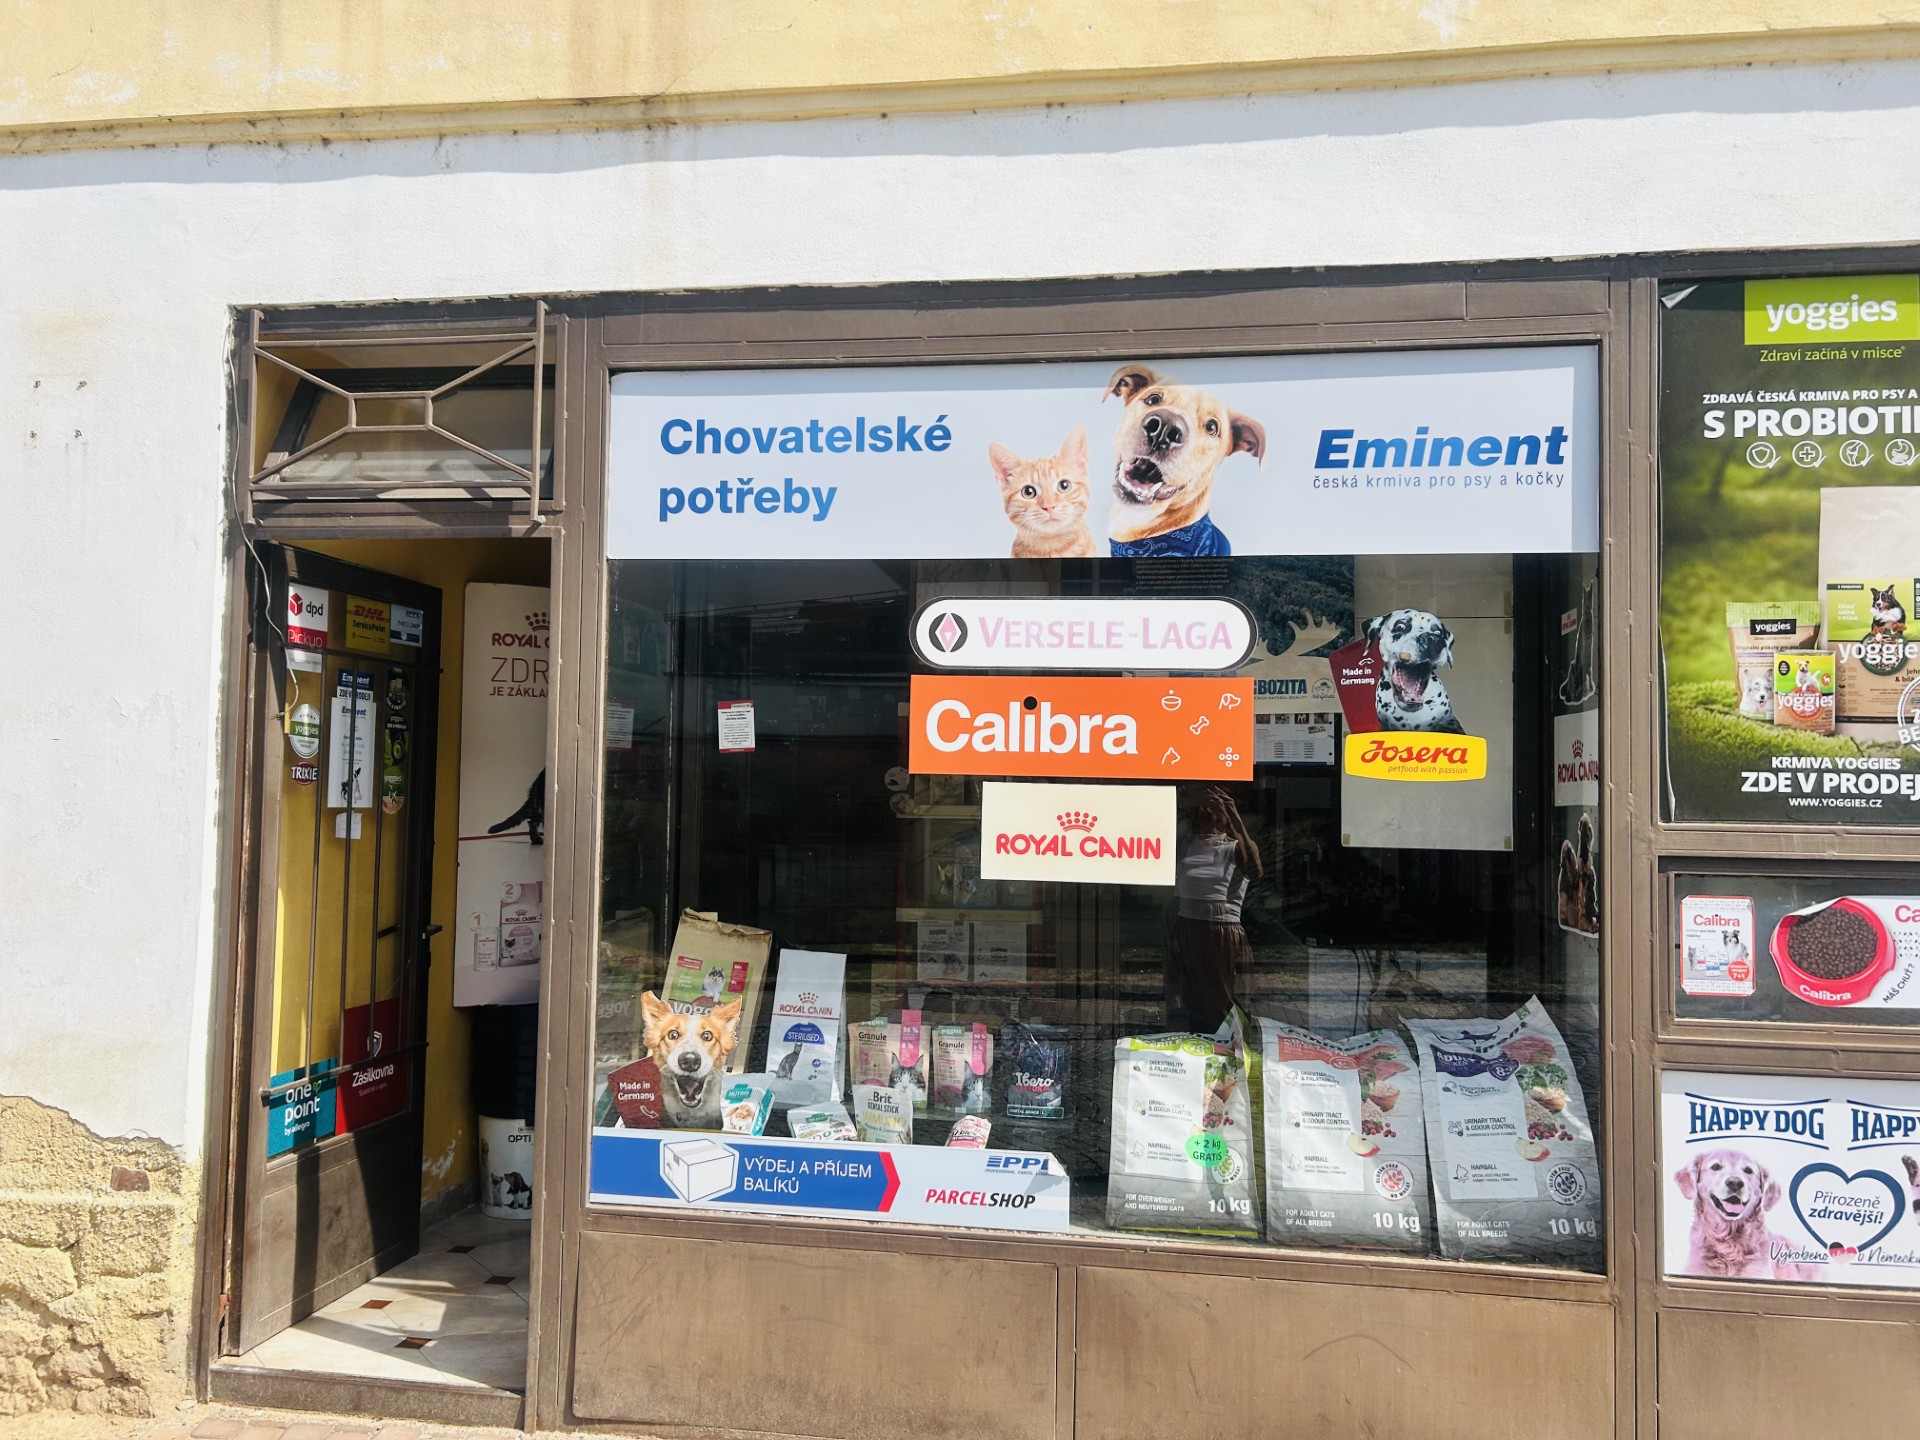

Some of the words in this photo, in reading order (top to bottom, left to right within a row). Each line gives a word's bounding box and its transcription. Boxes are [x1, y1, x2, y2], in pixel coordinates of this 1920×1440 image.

[1766, 294, 1897, 332] yoggies
[1760, 349, 1801, 362] Zdraví
[1804, 348, 1847, 361] začíná
[1850, 350, 1859, 359] v
[1702, 390, 1754, 404] ZDRAVÁ
[1757, 389, 1796, 402] ČESKÁ
[1799, 390, 1850, 401] KRMIVA
[1852, 390, 1878, 400] PRO
[1882, 389, 1905, 399] PSY
[1908, 388, 1918, 399] A
[1703, 409, 1726, 439] S
[1734, 405, 1920, 438] PROBIOTI
[660, 414, 952, 455] Chovatelské
[1314, 425, 1569, 470] Eminent
[1313, 473, 1358, 490] česká
[1366, 472, 1421, 488] krmiva
[1429, 475, 1456, 490] pro
[1464, 474, 1492, 490] psy
[1500, 475, 1508, 486] a
[1517, 471, 1565, 488] kočky
[659, 477, 837, 522] potřeby
[306, 601, 324, 618] dpd
[351, 604, 386, 621] DHL
[352, 619, 386, 633] ServicePoint
[1755, 622, 1791, 632] yoggies
[288, 629, 323, 647] Pickup
[491, 632, 541, 648] ROYAL
[1838, 638, 1919, 664] yoggie
[342, 672, 370, 685] Ement
[490, 657, 548, 684] ZDR
[1340, 677, 1375, 686] Germany
[489, 686, 504, 696] JE
[1777, 692, 1834, 710] yoggies
[342, 706, 367, 716] Ement
[926, 696, 1139, 755] Calibra
[1360, 740, 1468, 764] Josera
[1387, 765, 1419, 773] petfood
[1420, 765, 1437, 773] with
[1439, 766, 1468, 774] passion
[1771, 756, 1832, 769] KRMIVA
[1835, 756, 1901, 770] YOGGIES
[291, 766, 318, 780] TRIXIE
[1557, 762, 1578, 783] ROYAL
[1741, 771, 1792, 792] ZDE
[1797, 772, 1819, 793] V
[1823, 772, 1920, 801] PRODEJ
[1788, 798, 1883, 808] WWW.YOGGIES.CZ
[996, 833, 1073, 857] ROYAL
[1079, 836, 1162, 860] CANIN
[505, 884, 514, 895] 2
[1693, 913, 1740, 927] Calibra
[1799, 984, 1852, 1001] Calibra
[1882, 987, 1900, 1003] MÁŠ
[1897, 969, 1914, 989] CHUŤ
[779, 1004, 805, 1014] ROYAL
[808, 1006, 833, 1015] CANIN
[787, 1031, 820, 1042] STERILISED
[858, 1031, 887, 1041] Granule
[938, 1040, 965, 1049] Granule
[351, 1064, 394, 1087] Zásilkovna
[1015, 1072, 1054, 1087] Ibero
[285, 1083, 312, 1103] one
[619, 1081, 641, 1090] Made
[643, 1081, 651, 1089] in
[617, 1091, 655, 1101] Germany
[873, 1091, 892, 1104] Brit
[284, 1096, 320, 1126] point
[884, 1105, 899, 1114] STICK
[291, 1121, 310, 1133] allegro
[1689, 1101, 1770, 1135] HAPPY
[1774, 1108, 1825, 1140] DOG
[1851, 1108, 1920, 1142] HAPP
[508, 1134, 532, 1143] OPTI
[1212, 1139, 1221, 1150] kg
[1193, 1152, 1223, 1162] GRATIS
[1304, 1155, 1329, 1163] HAIRBALL
[744, 1155, 795, 1174] VÝDEJ
[799, 1160, 810, 1174] A
[814, 1157, 872, 1178] PŘÍJEM
[1230, 1165, 1241, 1182] WHEAT
[1376, 1165, 1385, 1184] GLUTEN
[743, 1176, 800, 1194] BALÍKŮ
[1399, 1181, 1411, 1197] WHEAT
[925, 1188, 1036, 1209] PARCELSHOP
[1125, 1202, 1137, 1210] AND
[1138, 1203, 1168, 1211] NEUTERED
[1138, 1194, 1176, 1205] OVERWEIGHT
[1208, 1198, 1226, 1213] 10
[1229, 1197, 1250, 1215] kg
[1814, 1190, 1881, 1209] Přirozeně
[1285, 1208, 1298, 1216] FOR
[1300, 1209, 1319, 1218] ADULT
[1319, 1211, 1336, 1219] CATS
[1808, 1206, 1884, 1226] zdravější!
[1286, 1218, 1295, 1226] OF
[1308, 1219, 1333, 1227] BREEDS
[1372, 1212, 1393, 1228] 10
[1398, 1212, 1420, 1233] kg
[1493, 1220, 1510, 1228] CATS
[1548, 1218, 1570, 1235] 10
[1575, 1217, 1597, 1238] kg
[1458, 1229, 1467, 1237] OF
[1468, 1229, 1480, 1237] ALL
[1482, 1229, 1508, 1237] BREEDS
[1770, 1242, 1829, 1265] Vyrobeno
